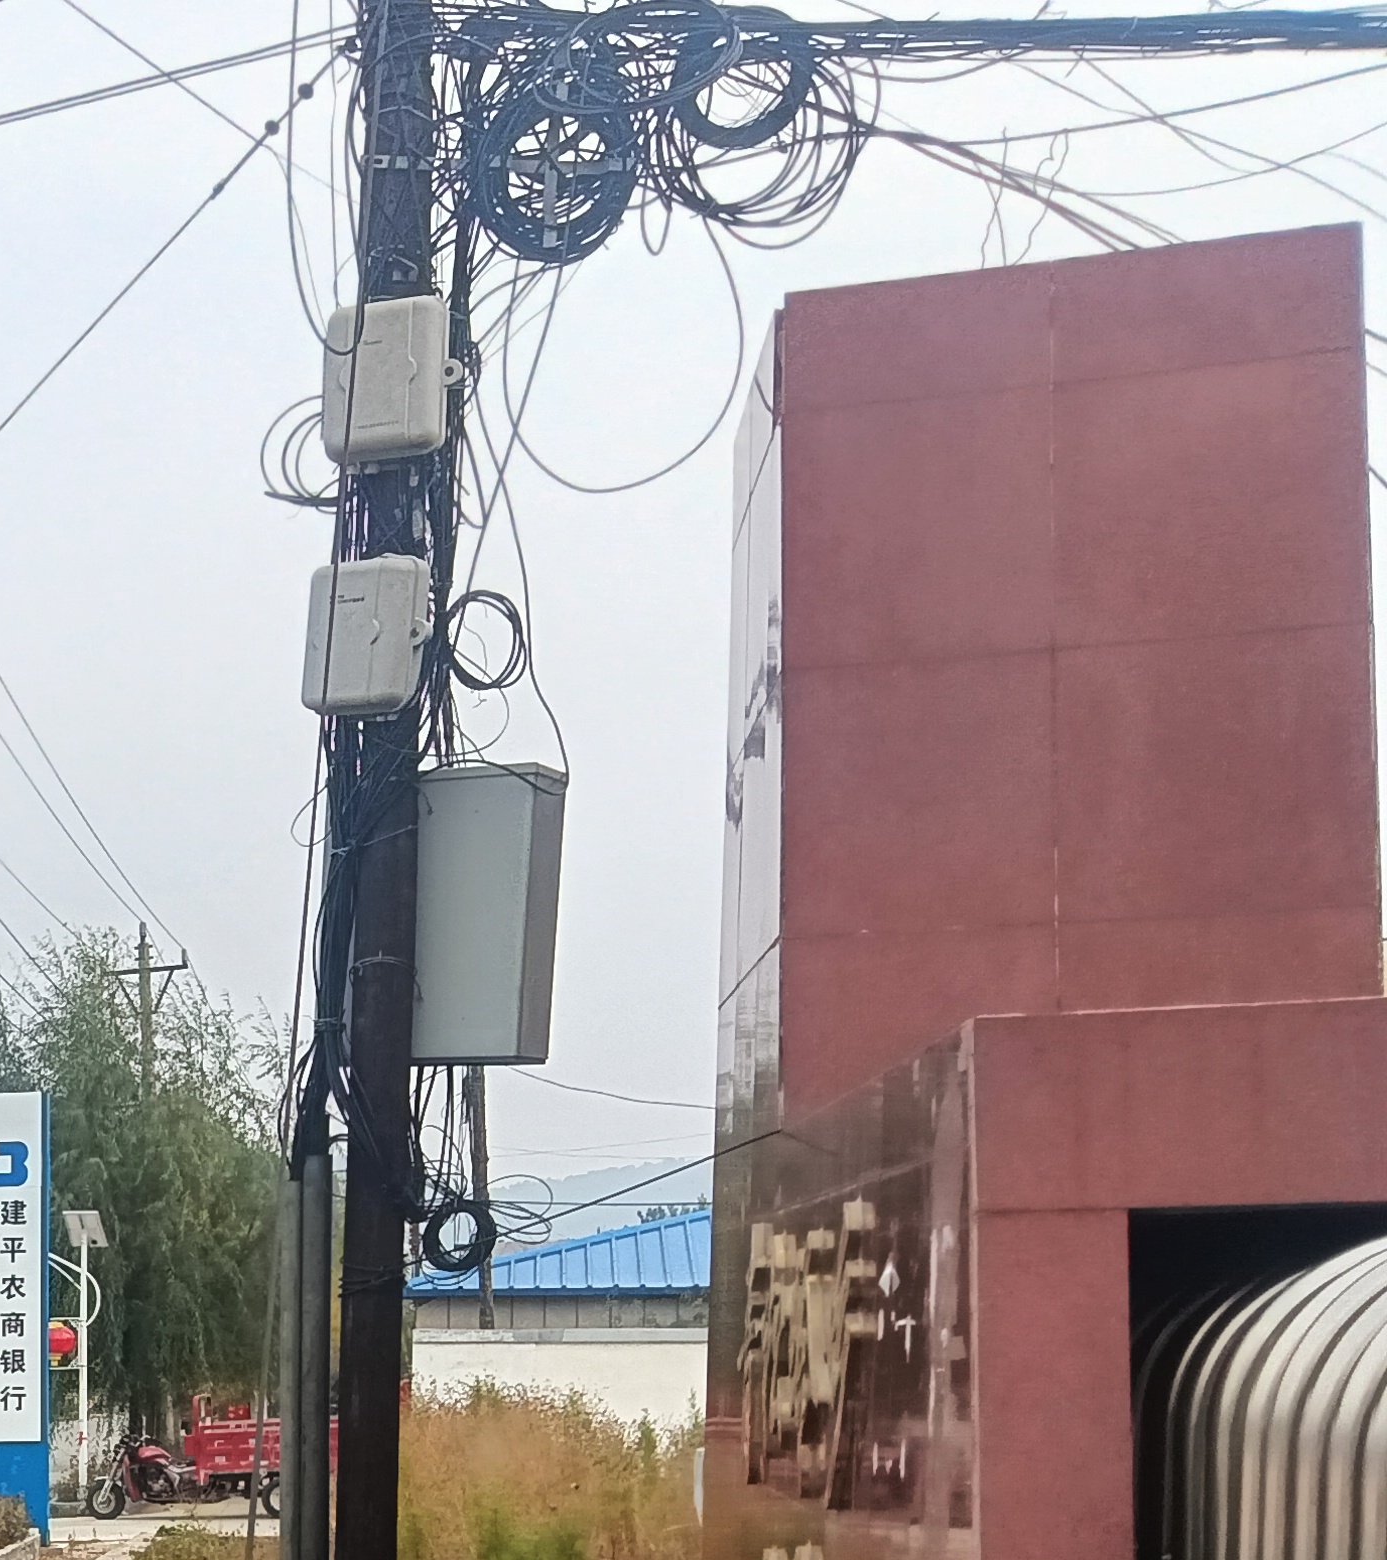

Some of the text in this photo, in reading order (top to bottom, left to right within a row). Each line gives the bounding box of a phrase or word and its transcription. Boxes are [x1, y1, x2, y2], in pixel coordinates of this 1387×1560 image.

[0, 1199, 27, 1413] 建平农商银行
